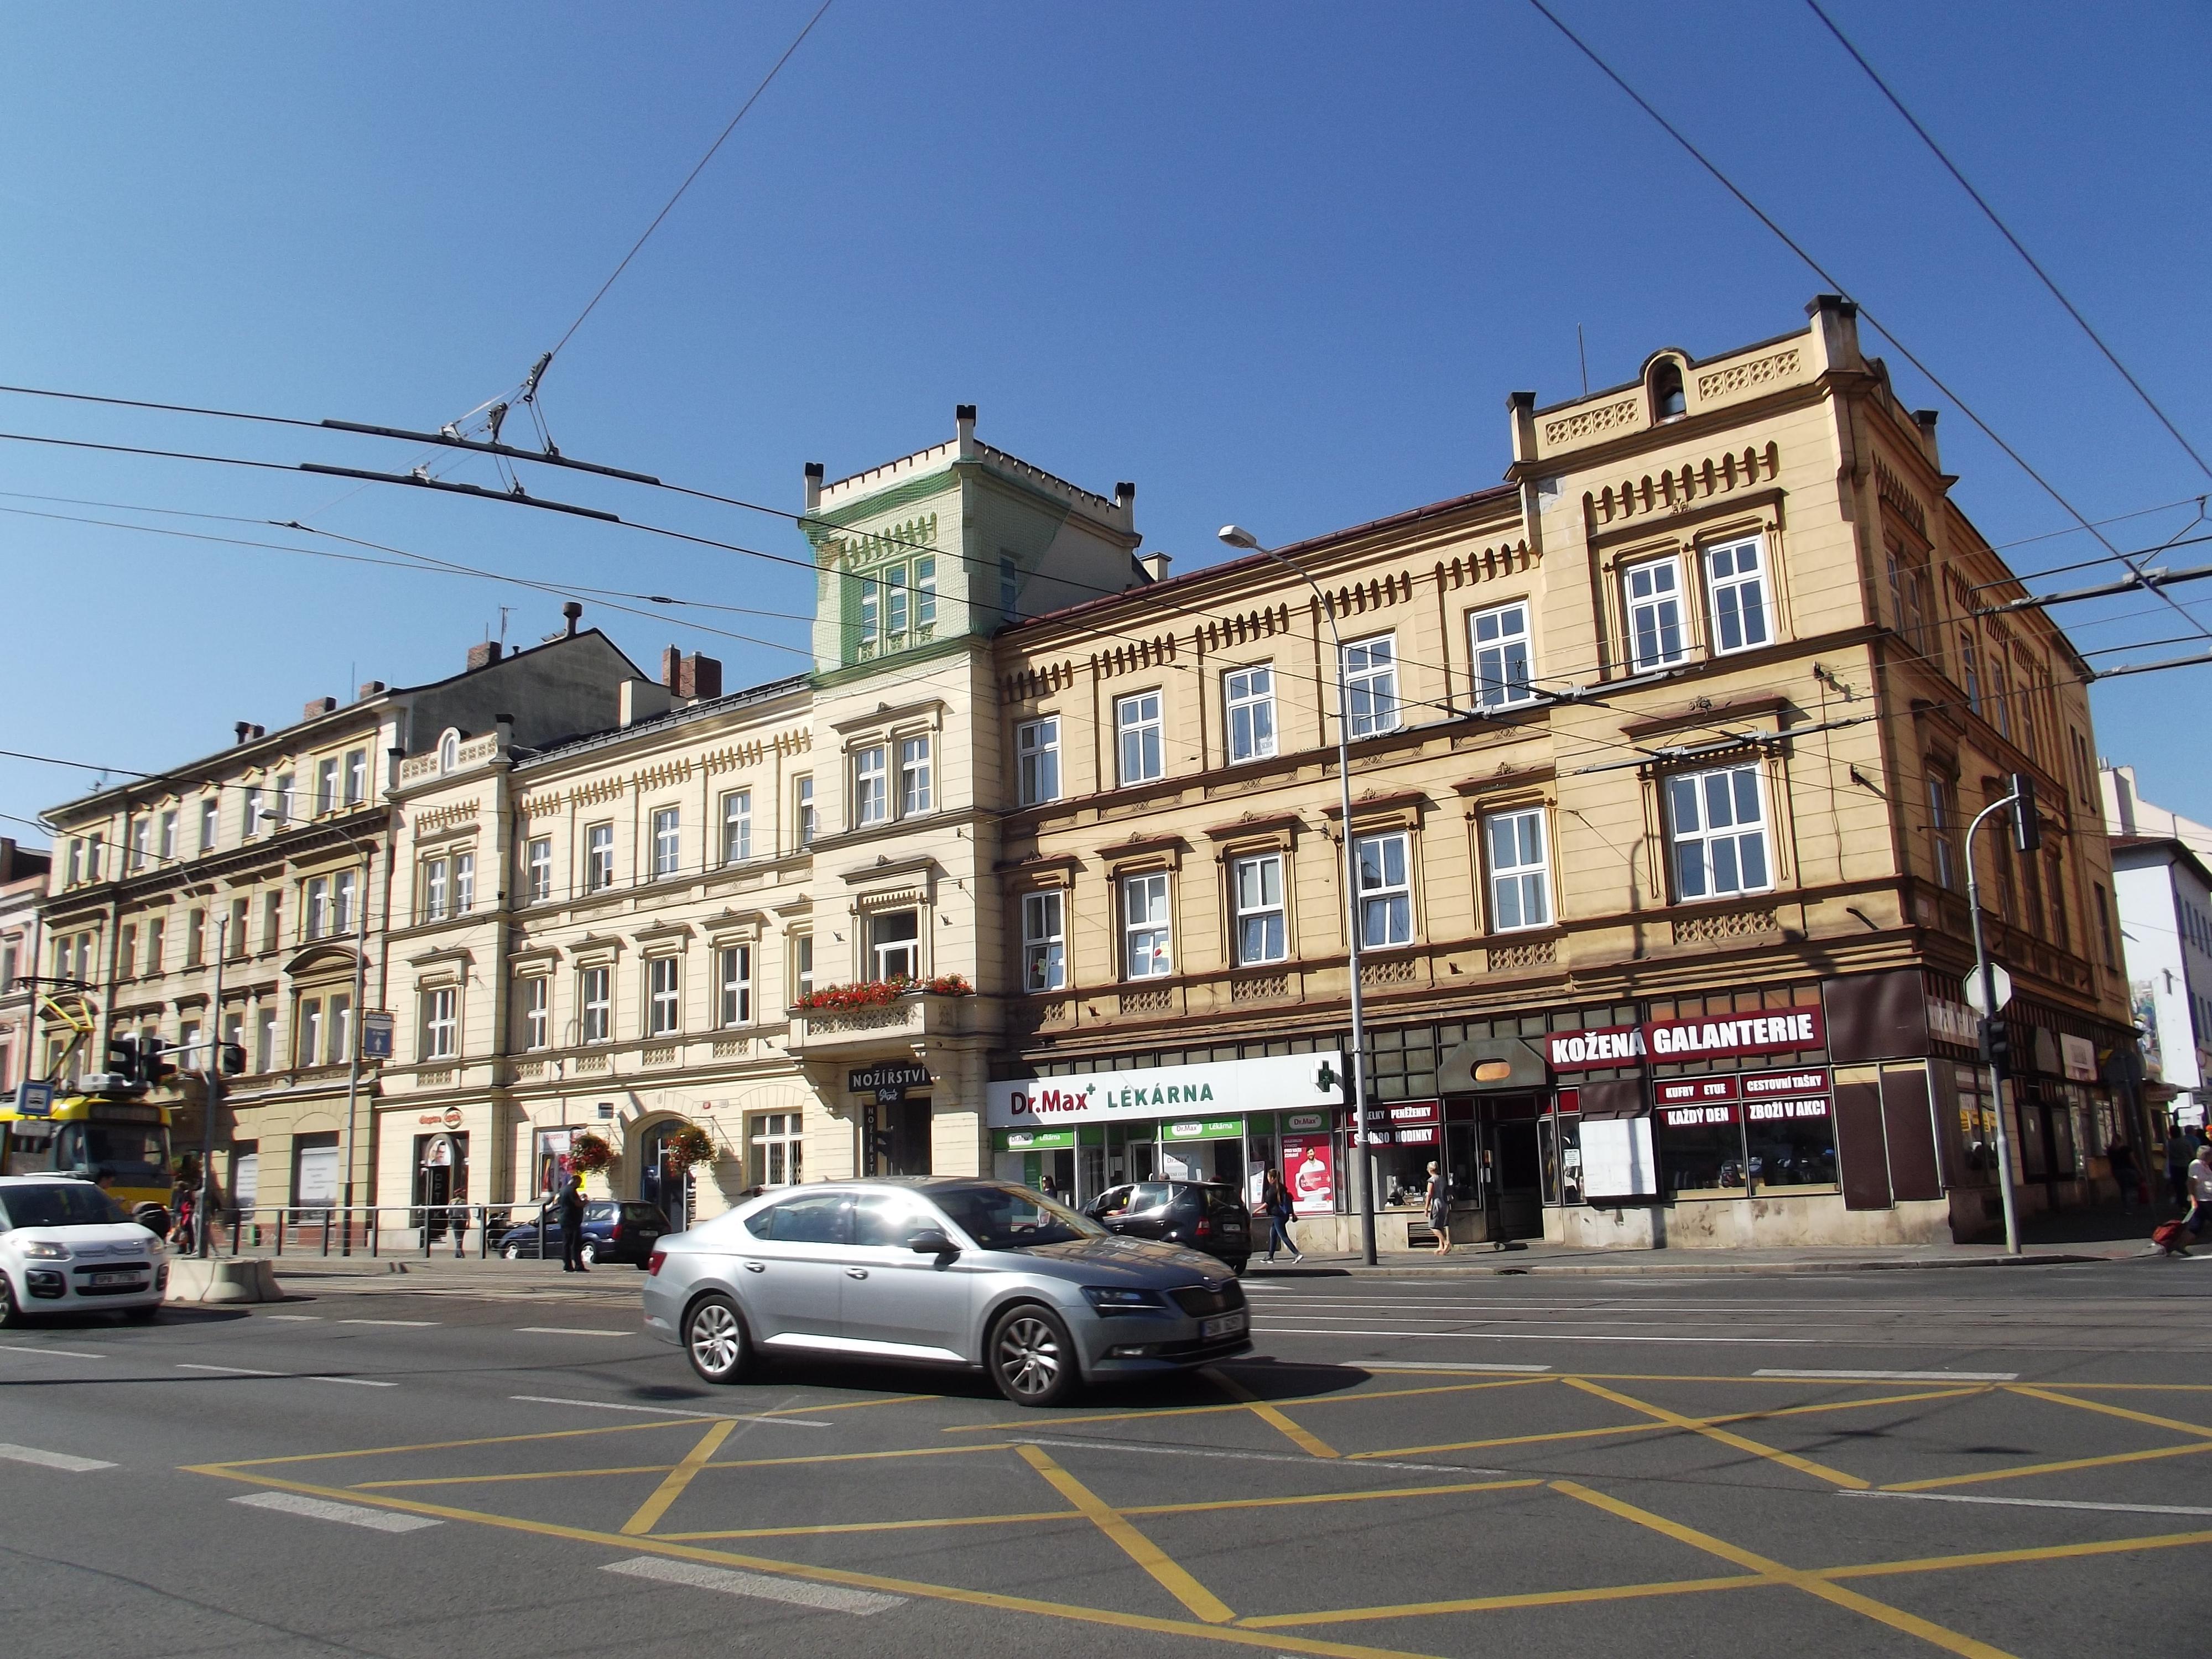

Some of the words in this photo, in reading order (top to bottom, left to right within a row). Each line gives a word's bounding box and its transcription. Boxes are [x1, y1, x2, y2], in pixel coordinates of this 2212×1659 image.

[1552, 1028, 1646, 1063] KOŽENÁ
[1653, 1013, 1814, 1054] GALANTERIE
[853, 1066, 926, 1088] NOŽÍŘSTVÍ
[1747, 1076, 1792, 1092] CESTOVNÍ
[1792, 1074, 1821, 1088] TAŠKY
[1107, 1082, 1214, 1108] LÉKÁRNA
[1665, 1086, 1694, 1098] KUFRY
[1704, 1083, 1726, 1095] ETUE
[1353, 1110, 1385, 1121] KELKY
[1391, 1107, 1431, 1119] PENĚŽENKY
[1668, 1107, 1705, 1125] KAŽDÝ
[1705, 1107, 1729, 1123] DEN
[1750, 1102, 1783, 1119] ZBOŽÍ
[1784, 1102, 1795, 1117] V
[1795, 1100, 1825, 1115] AKCI
[1395, 1129, 1433, 1142] HODINKY
